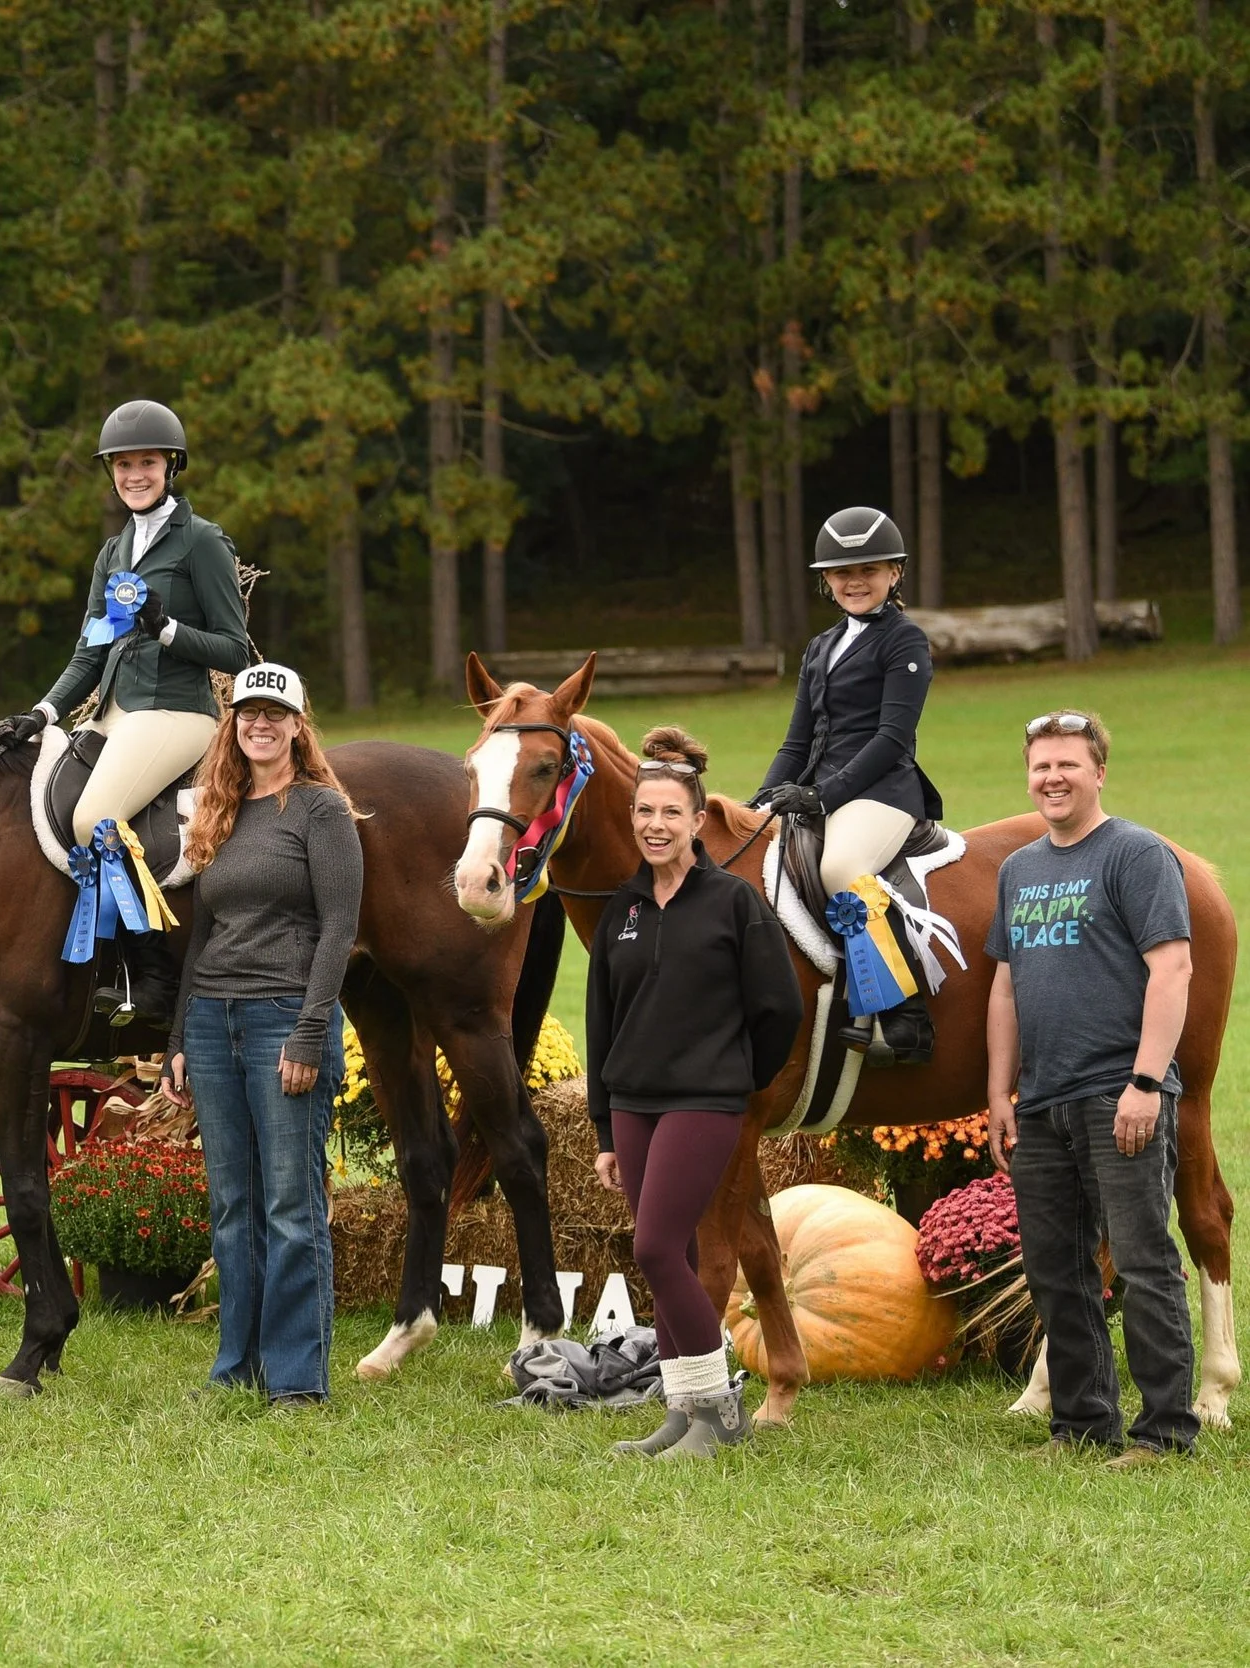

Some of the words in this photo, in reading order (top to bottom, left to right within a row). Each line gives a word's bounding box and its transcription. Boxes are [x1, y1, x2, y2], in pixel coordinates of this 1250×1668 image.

[245, 671, 287, 694] CBEQ
[1018, 885, 1050, 902] THIS
[1052, 882, 1066, 899] IS
[1065, 879, 1091, 895] MY
[1010, 895, 1088, 925] HAPPY
[1010, 920, 1080, 950] PLACE
